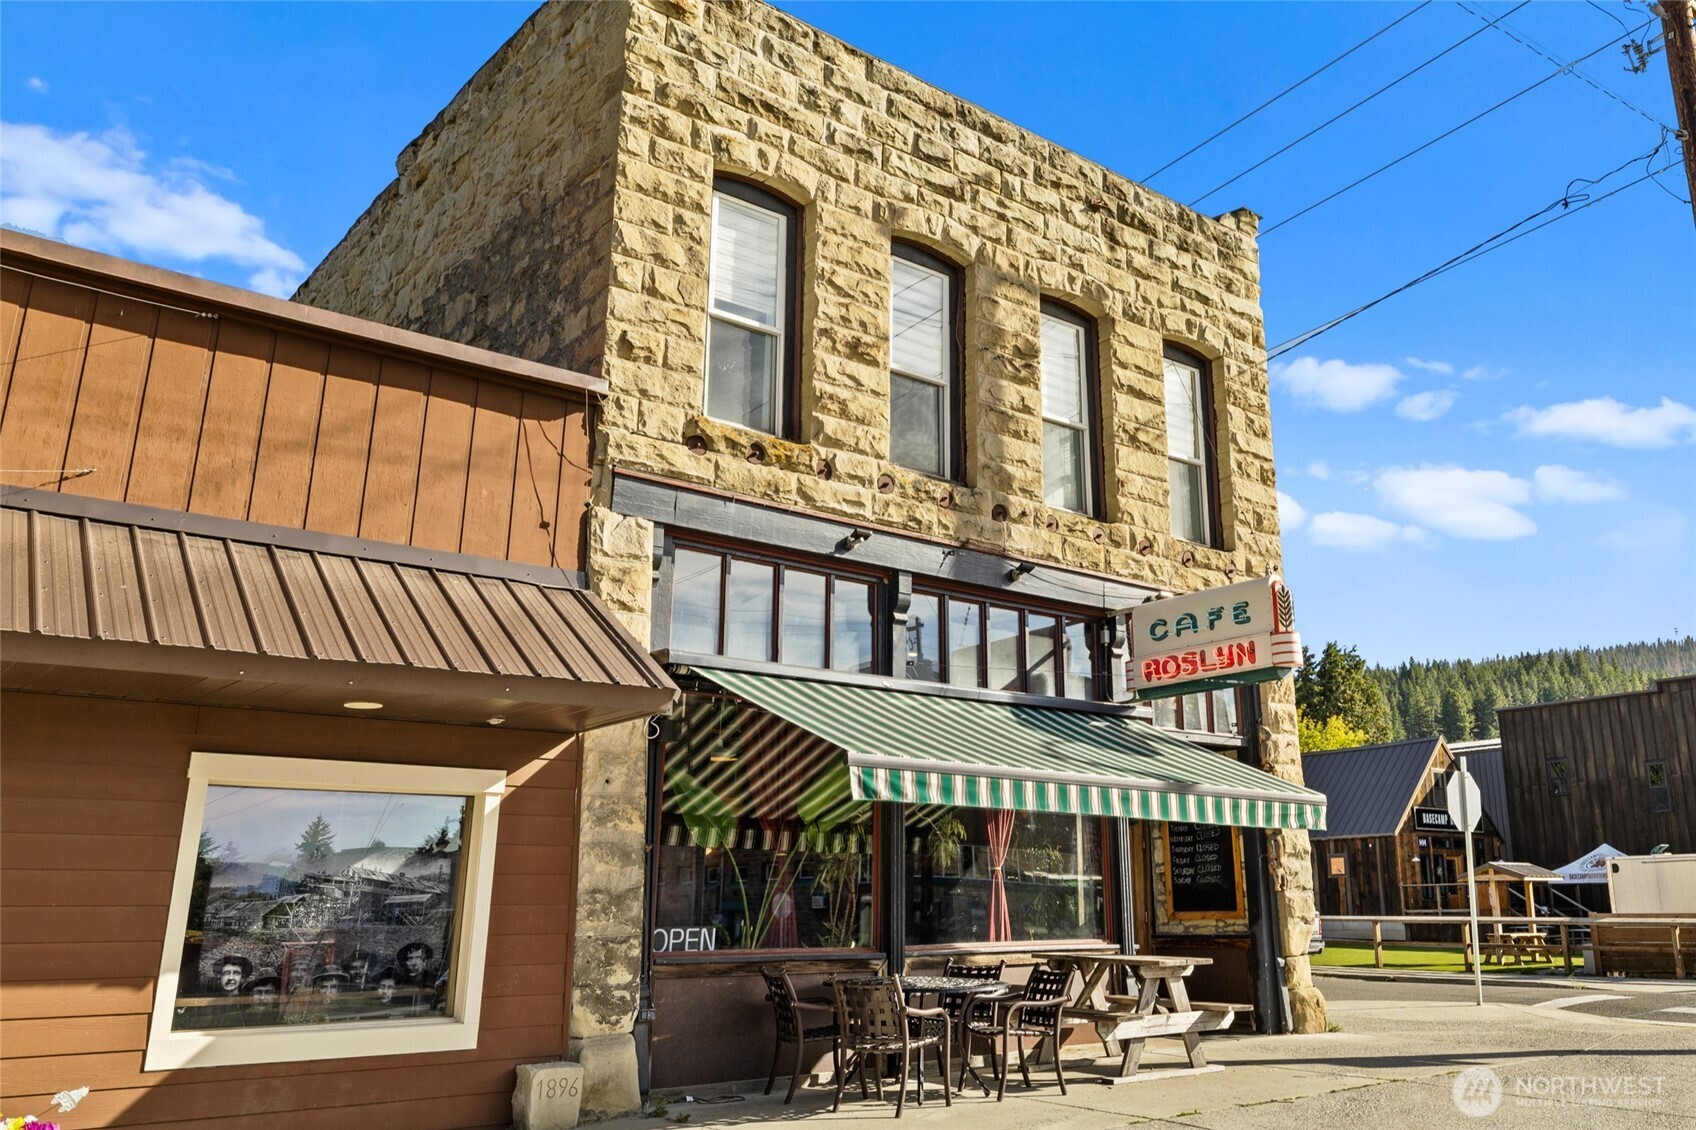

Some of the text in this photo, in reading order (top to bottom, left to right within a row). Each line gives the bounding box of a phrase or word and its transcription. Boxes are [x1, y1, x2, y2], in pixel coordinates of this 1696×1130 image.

[1149, 601, 1251, 641] CAFE
[1141, 640, 1256, 682] ROSLYN
[1422, 812, 1448, 825] BASECAMP
[1195, 843, 1219, 852] CLOSED
[1195, 854, 1218, 862] CLOSED
[1197, 865, 1221, 873] CLOSED
[653, 928, 717, 952] OPEN
[537, 1077, 578, 1100] 1896
